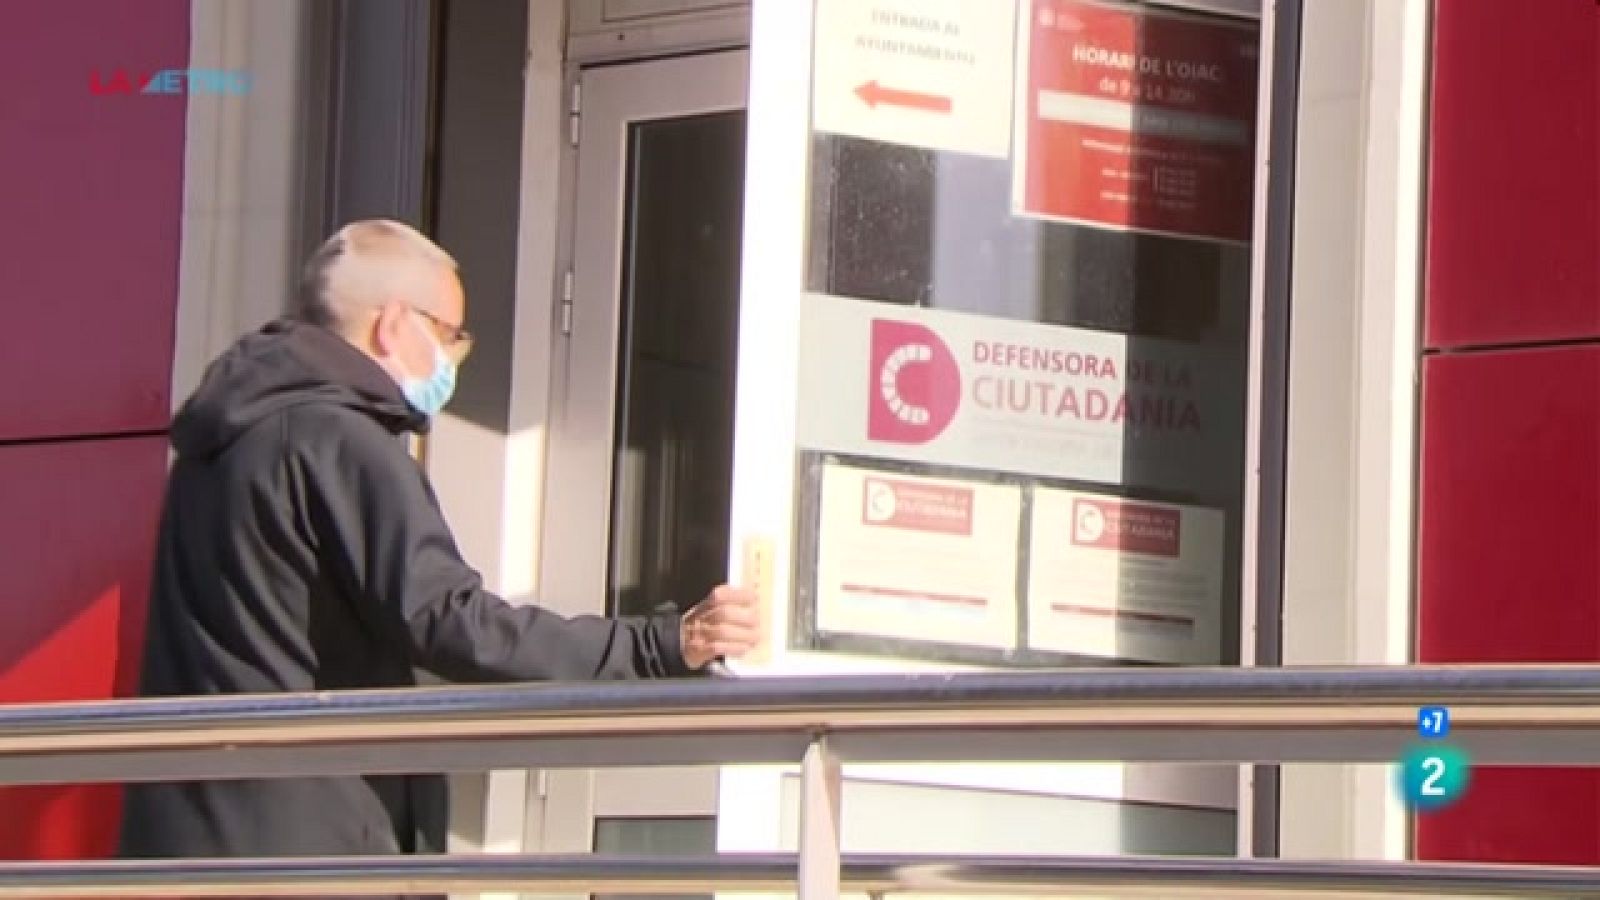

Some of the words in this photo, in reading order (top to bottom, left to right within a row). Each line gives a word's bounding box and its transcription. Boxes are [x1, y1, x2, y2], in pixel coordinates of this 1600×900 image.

[1139, 56, 1161, 76] DE
[972, 340, 1118, 381] DEFENSORA
[1128, 358, 1156, 386] DE
[1163, 362, 1192, 390] LA
[971, 374, 1202, 433] CIUTADANIA
